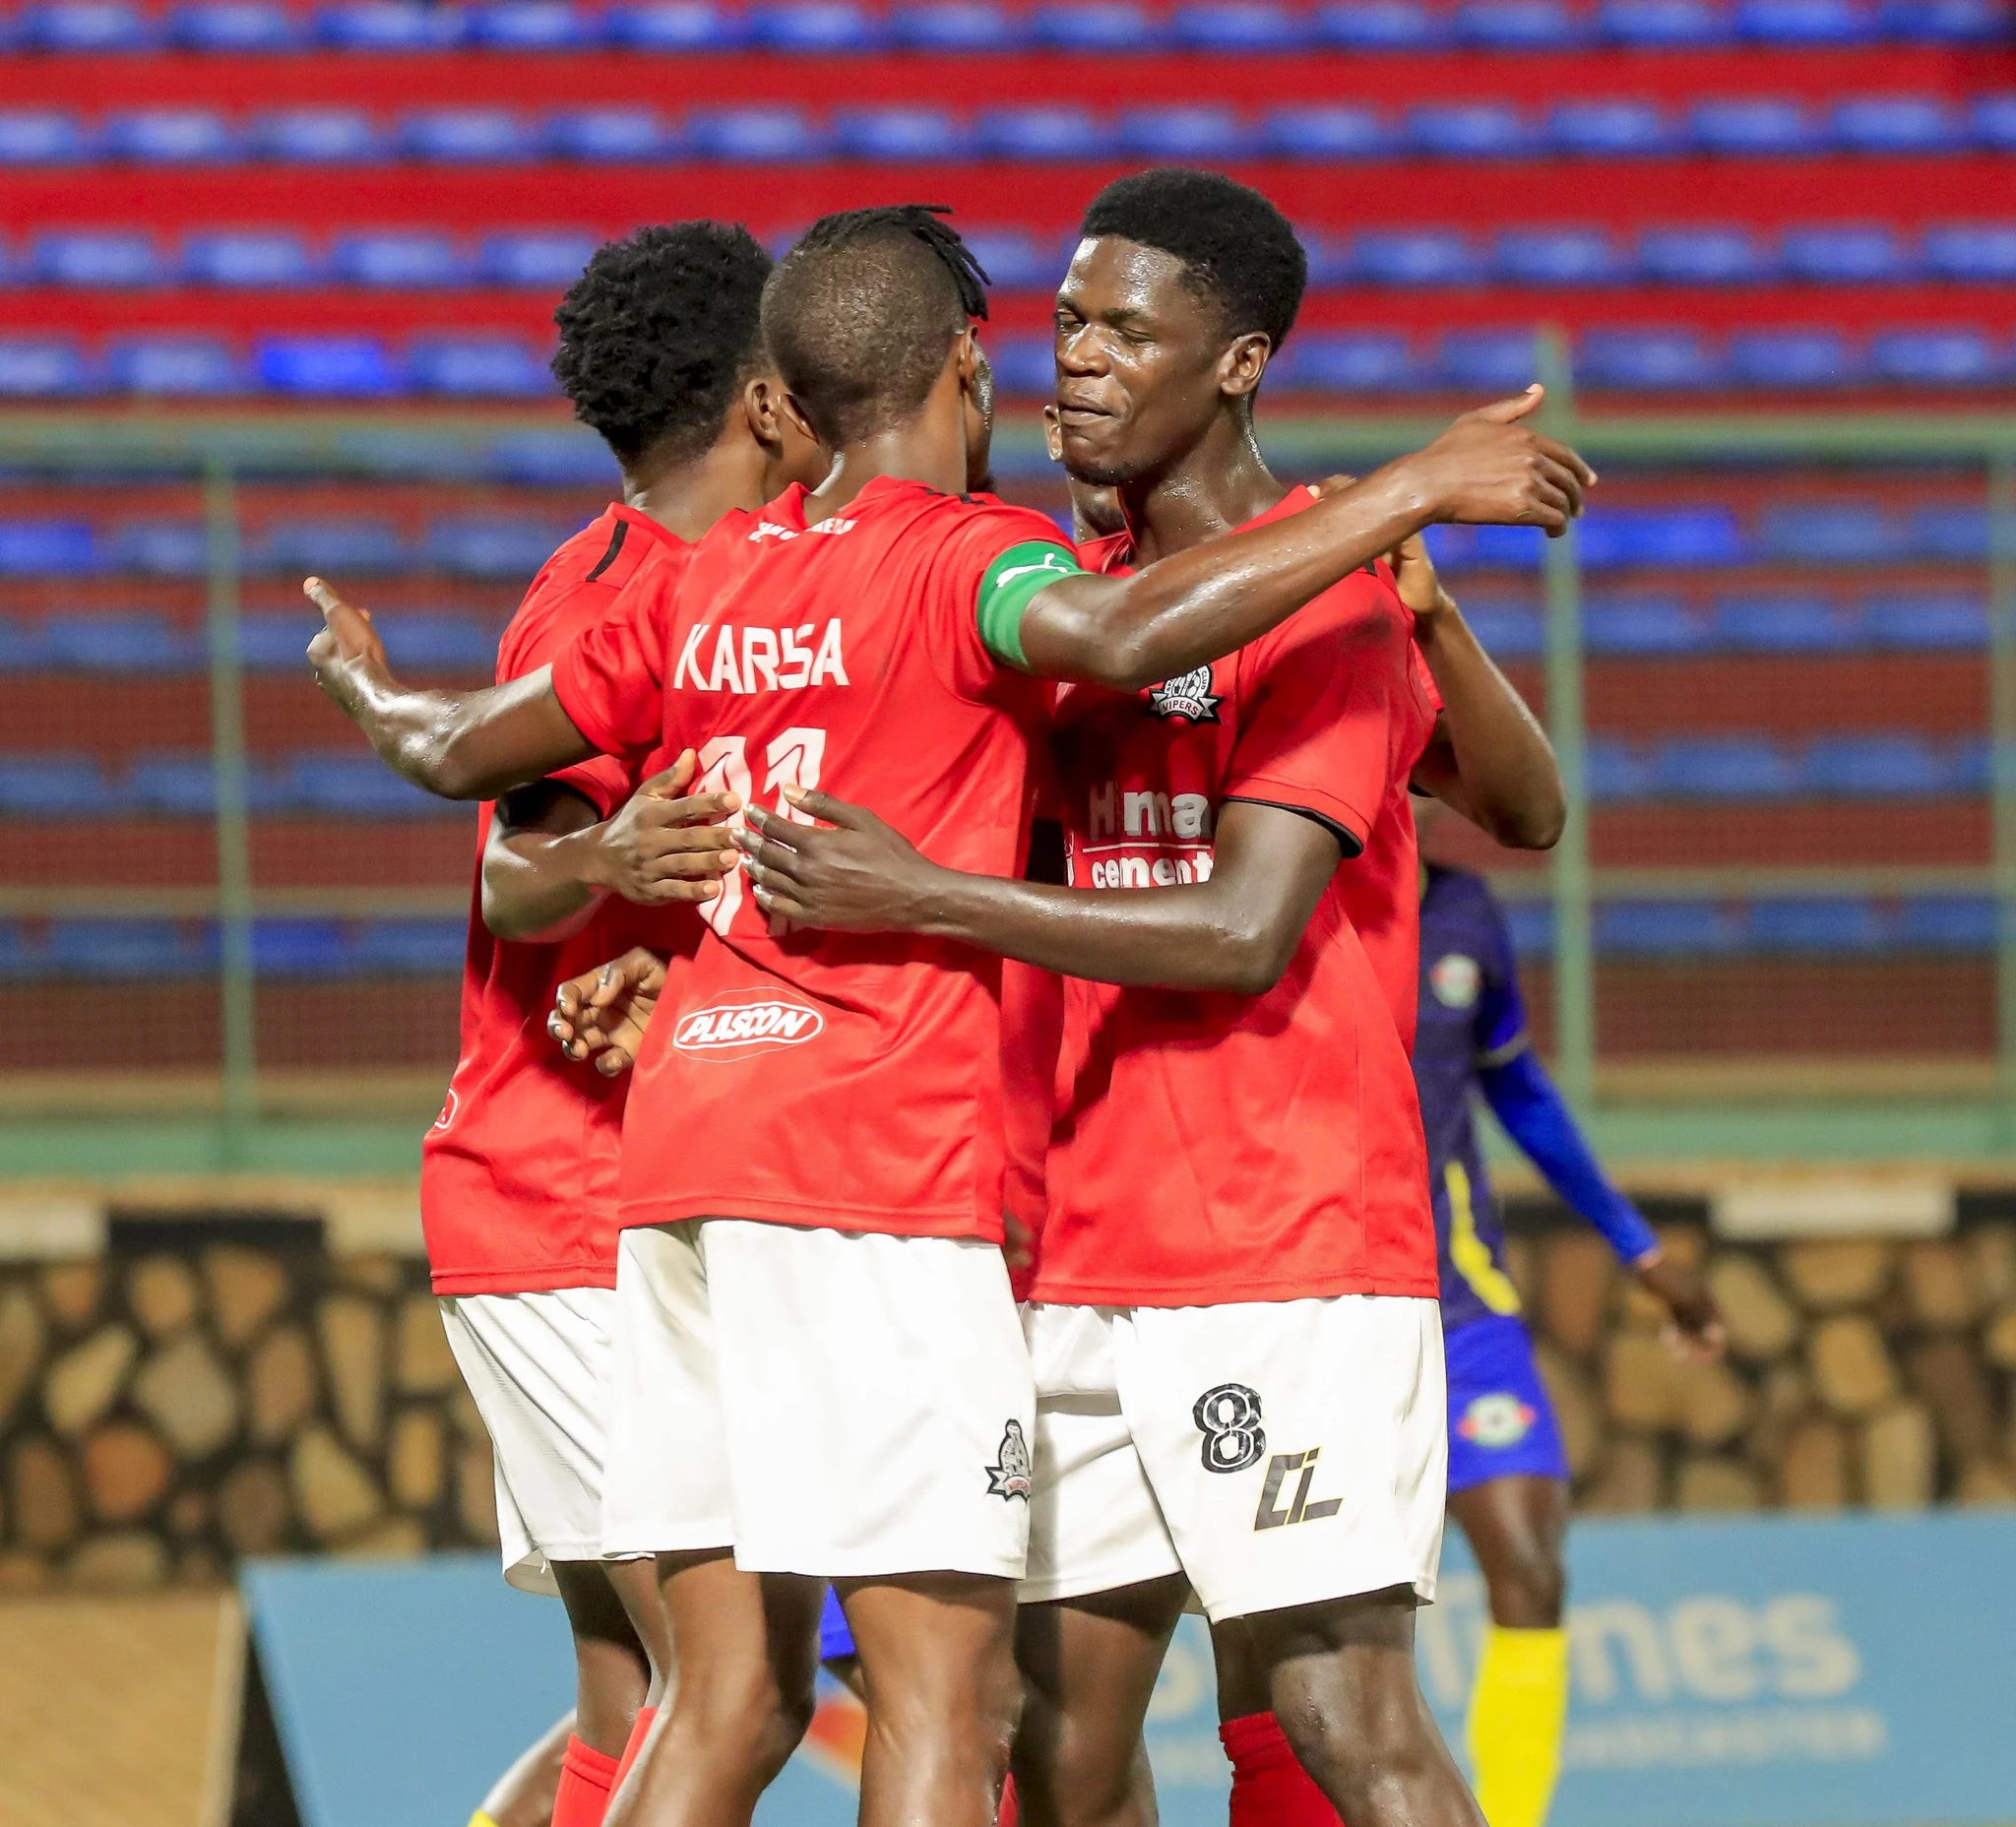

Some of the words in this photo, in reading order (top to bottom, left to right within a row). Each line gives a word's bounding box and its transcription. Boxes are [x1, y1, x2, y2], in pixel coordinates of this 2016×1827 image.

[1162, 700, 1199, 716] VIPERS
[1090, 781, 1213, 842] Hma
[1092, 851, 1214, 889] cement
[678, 1006, 812, 1042] PLASCON
[1192, 1383, 1267, 1474] 8
